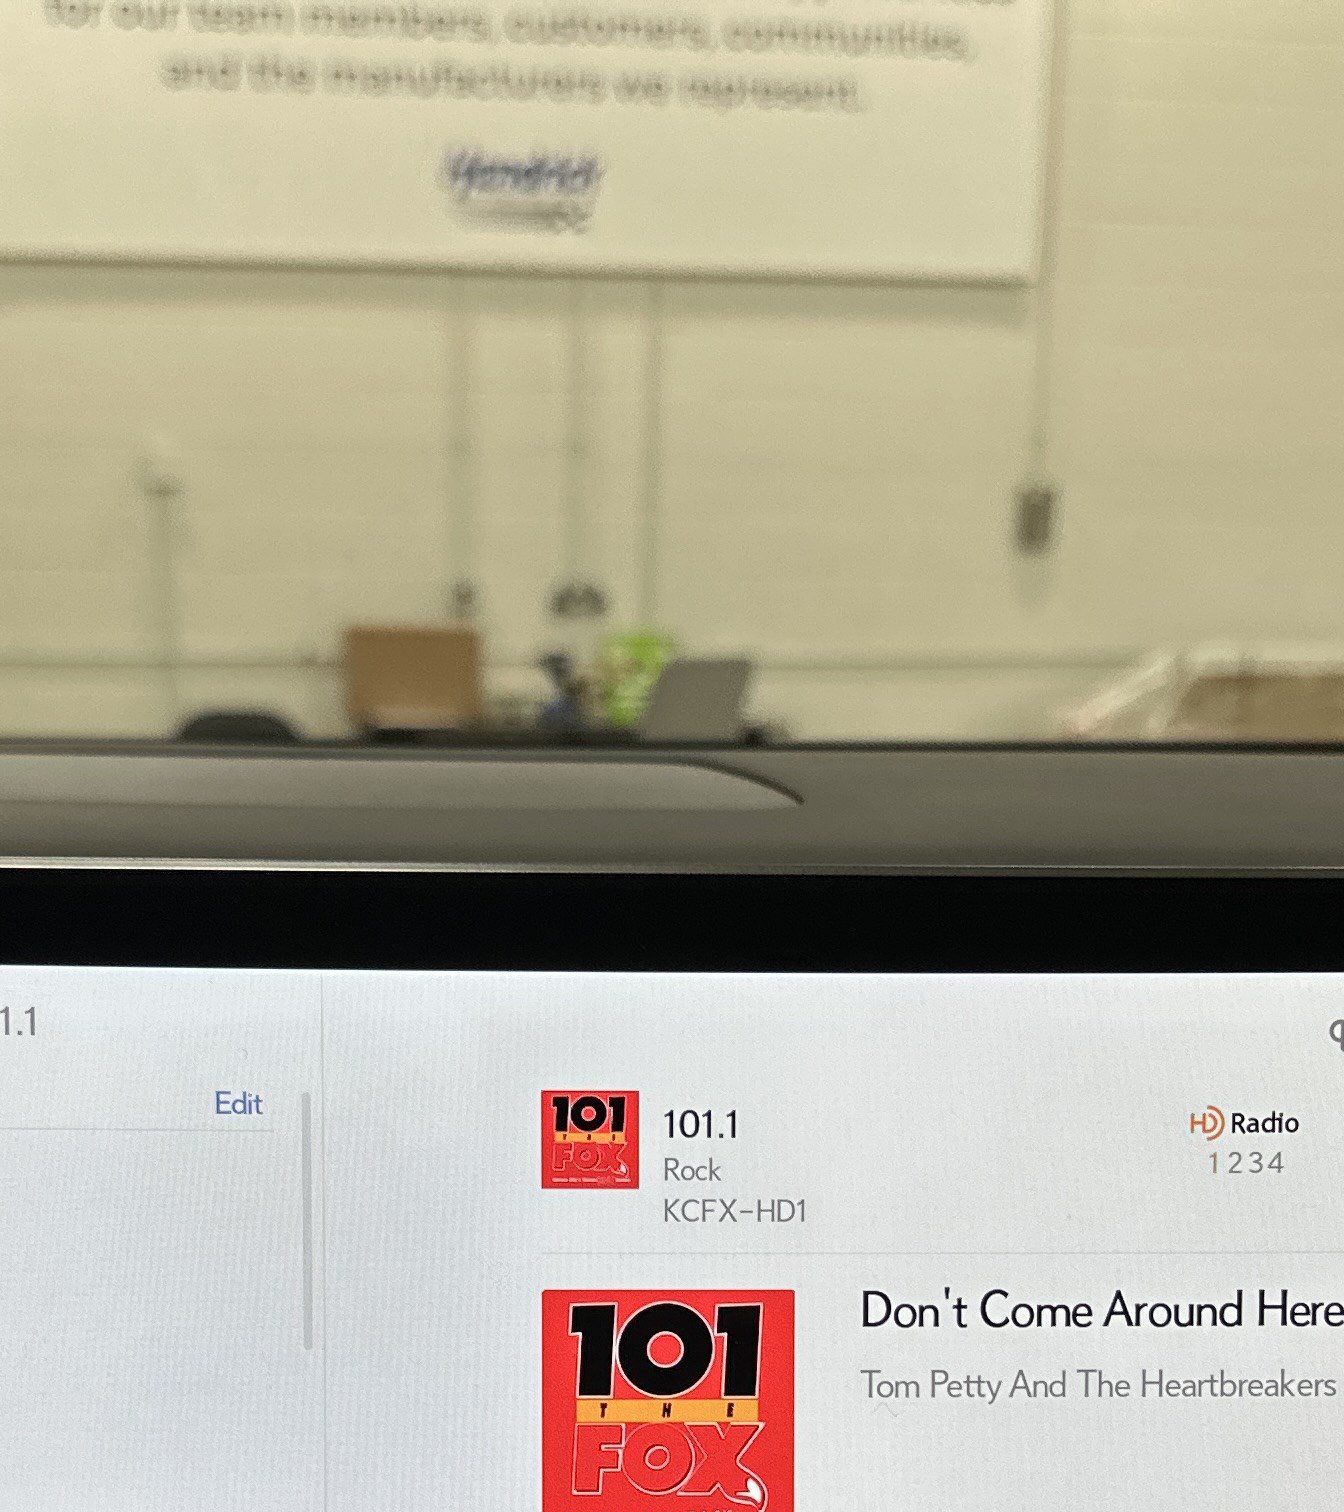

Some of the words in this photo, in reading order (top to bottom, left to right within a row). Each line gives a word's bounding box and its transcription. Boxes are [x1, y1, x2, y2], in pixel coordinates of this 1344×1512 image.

[613, 68, 671, 102] we
[215, 1090, 264, 1115] Edit
[551, 1095, 626, 1132] 101
[664, 1109, 737, 1139] 101.1
[1231, 1110, 1300, 1135] Radio
[551, 1142, 630, 1179] FOX
[663, 1156, 722, 1182] Rock
[862, 1286, 968, 1329] Don't
[979, 1288, 1094, 1329] Come
[1102, 1289, 1244, 1328] Around
[568, 1300, 764, 1400] 101
[859, 1368, 921, 1399] Tom
[930, 1368, 1003, 1406] Petty
[1008, 1368, 1067, 1399] And
[1075, 1368, 1131, 1398] The
[1141, 1367, 1337, 1398] Heartbreakers
